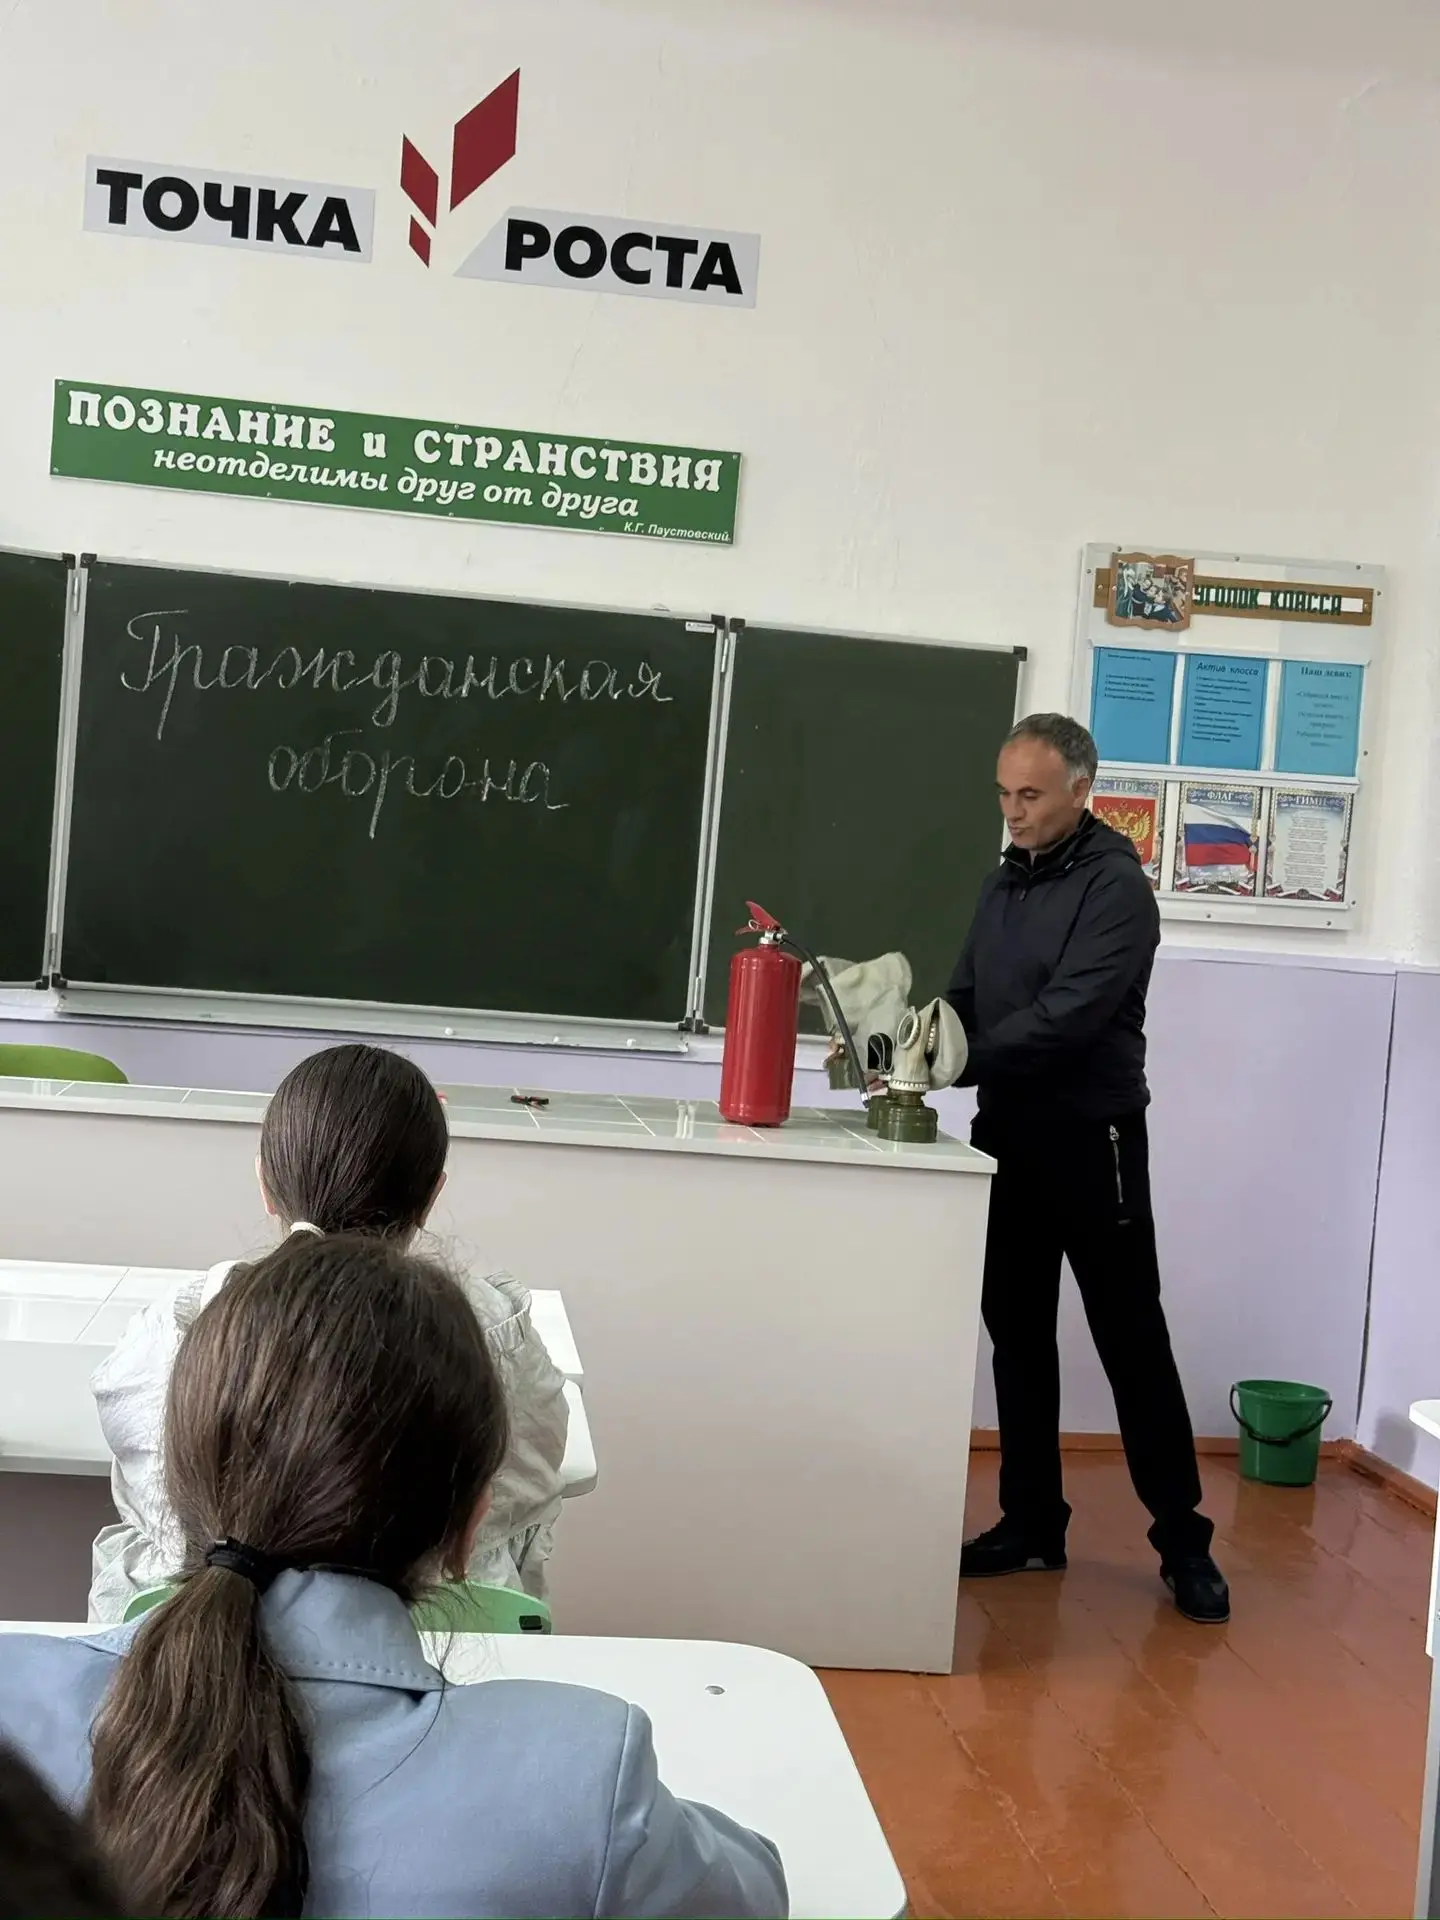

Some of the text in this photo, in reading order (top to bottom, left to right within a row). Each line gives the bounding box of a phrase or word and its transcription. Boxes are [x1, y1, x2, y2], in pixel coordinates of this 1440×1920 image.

[97, 168, 743, 295] ТОЧКА РОСТА
[67, 390, 723, 492] ПОЗНАНИЕ и СТРАНСТВИЯ
[153, 449, 639, 519] неотделимы друг от друга
[624, 521, 729, 541] К.Г. Паустовский
[1270, 590, 1341, 615] КЛАССА
[120, 609, 673, 740] Гражданская
[1196, 661, 1226, 673] Актив
[1301, 665, 1322, 676] Наш
[268, 729, 569, 839] оборона
[1207, 790, 1234, 801] ФЛАГ
[1295, 795, 1327, 805] ГИМН
